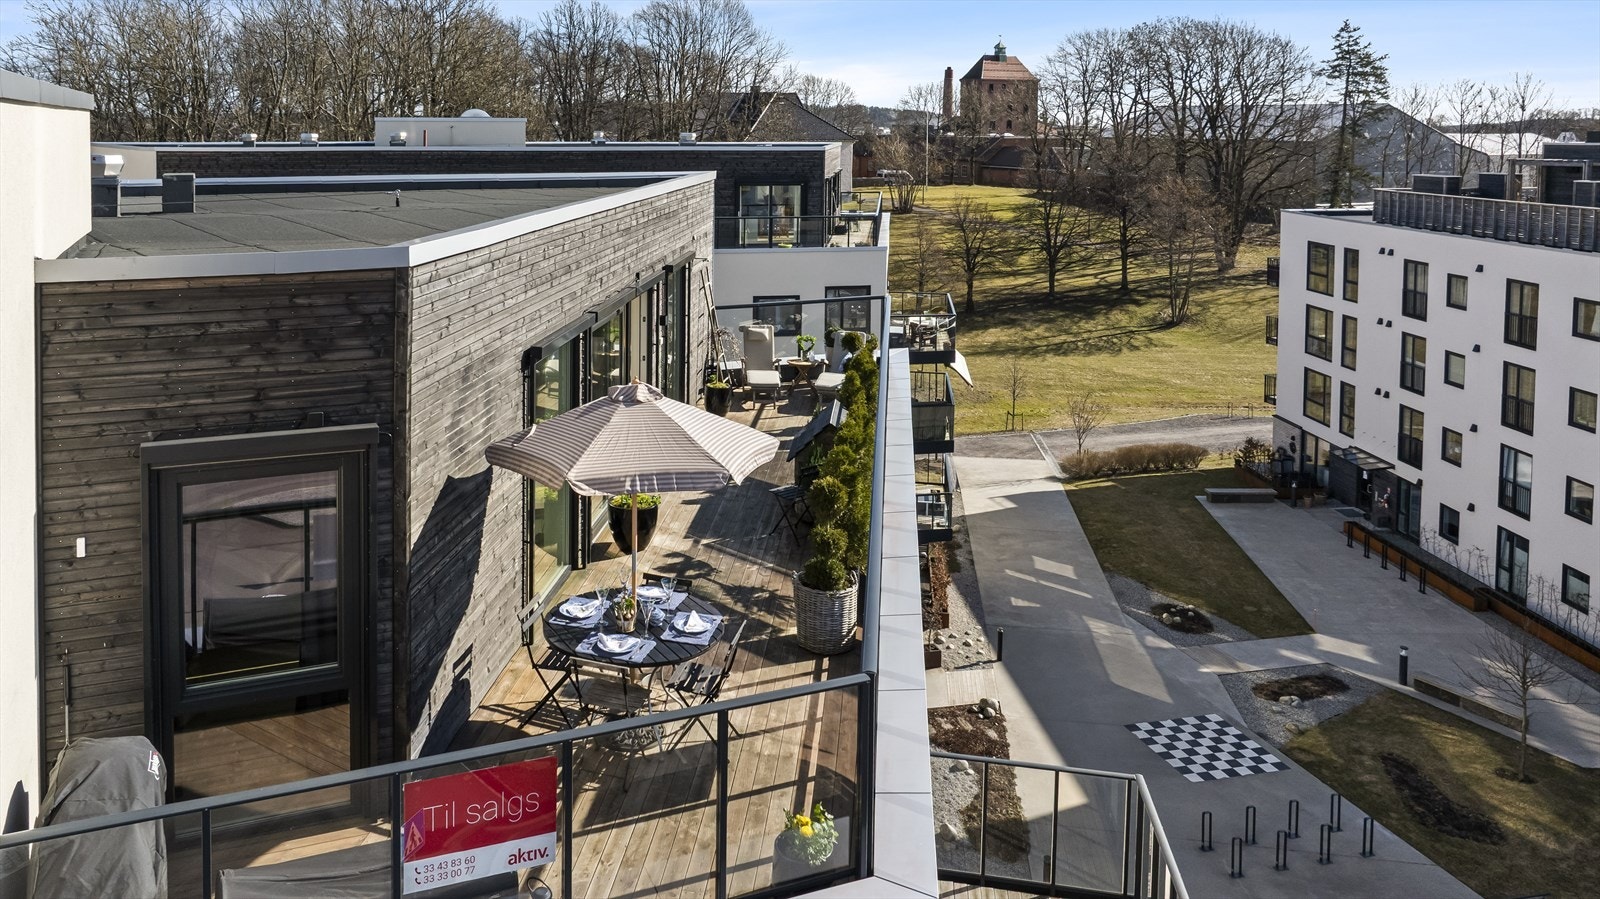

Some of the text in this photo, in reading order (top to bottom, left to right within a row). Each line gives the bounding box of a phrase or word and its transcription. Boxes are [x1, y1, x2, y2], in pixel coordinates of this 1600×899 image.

[423, 791, 540, 832] Til salgs
[423, 855, 476, 874] 33 43 83 60
[423, 865, 476, 885] 33 33 00 77
